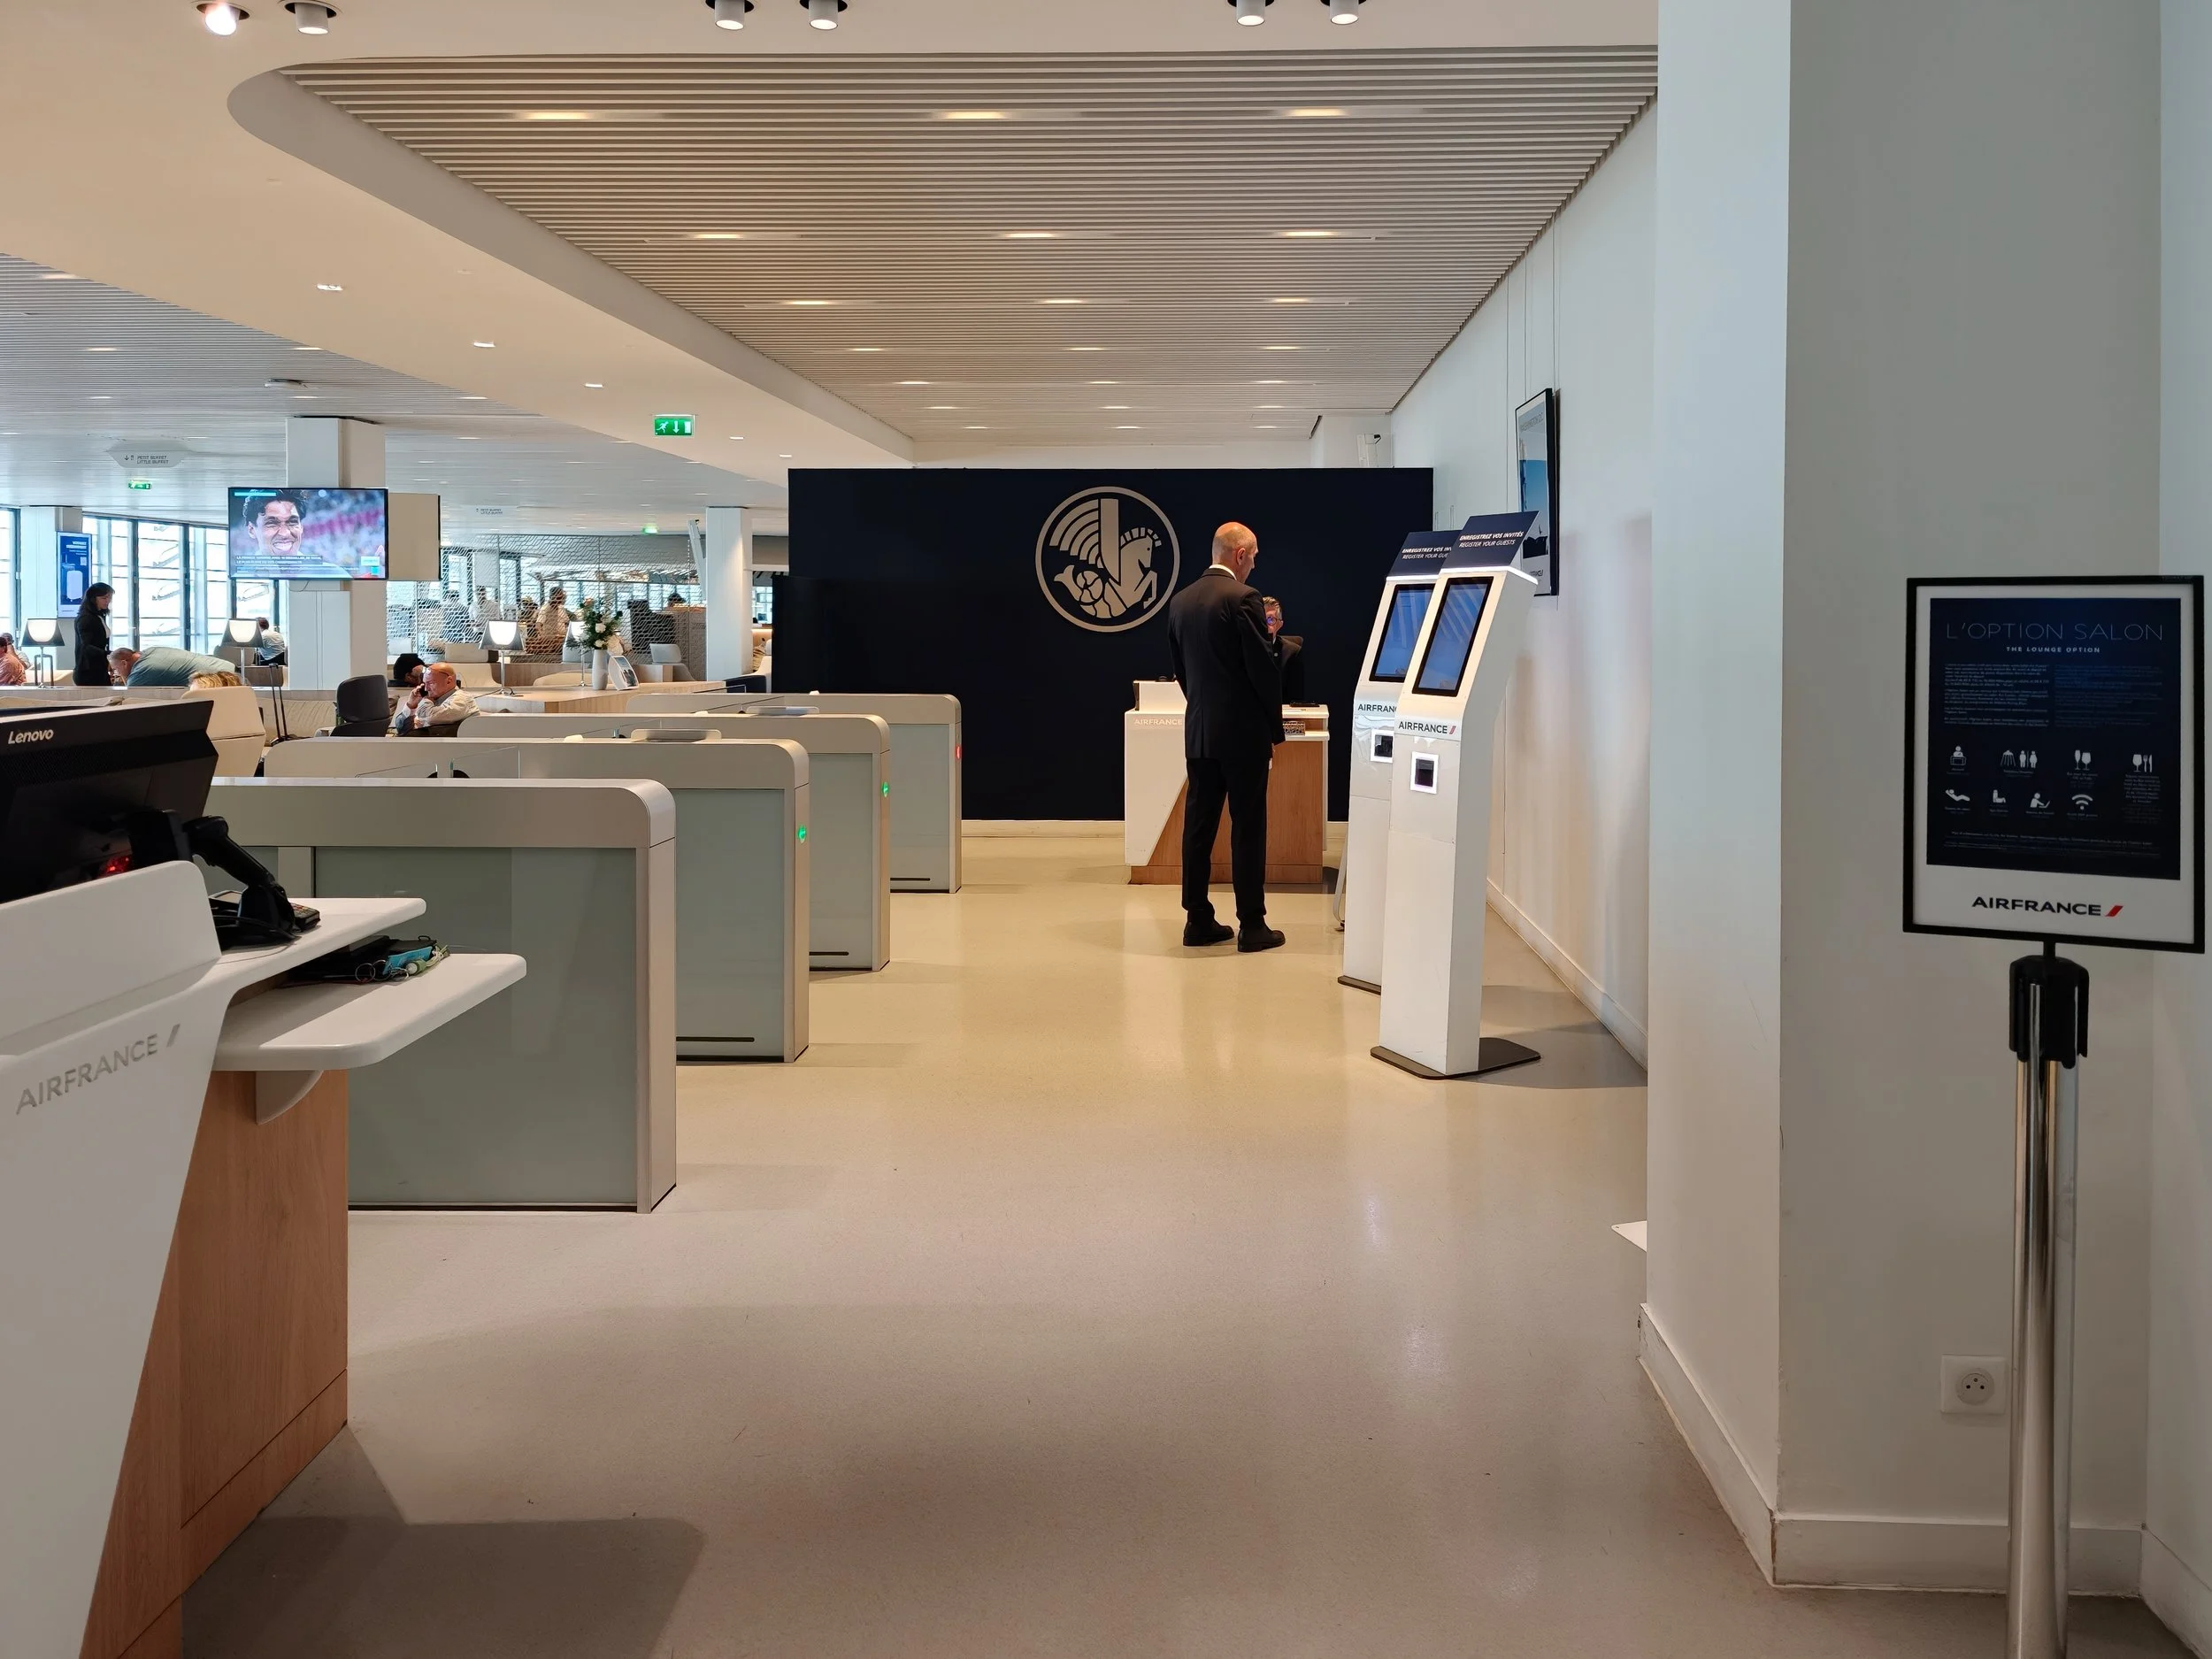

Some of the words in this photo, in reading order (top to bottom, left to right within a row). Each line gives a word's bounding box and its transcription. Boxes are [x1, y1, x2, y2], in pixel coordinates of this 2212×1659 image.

[1459, 533, 1493, 541] ENREGISTREZ
[1946, 622, 2063, 641] L'OPTION
[2074, 622, 2163, 641] SALON
[1398, 721, 1448, 734] AIRFRANCE
[8, 729, 54, 744] Lenovo
[1971, 896, 2101, 917] AIRFRANCE
[15, 1033, 157, 1115] AIRFRANCE
